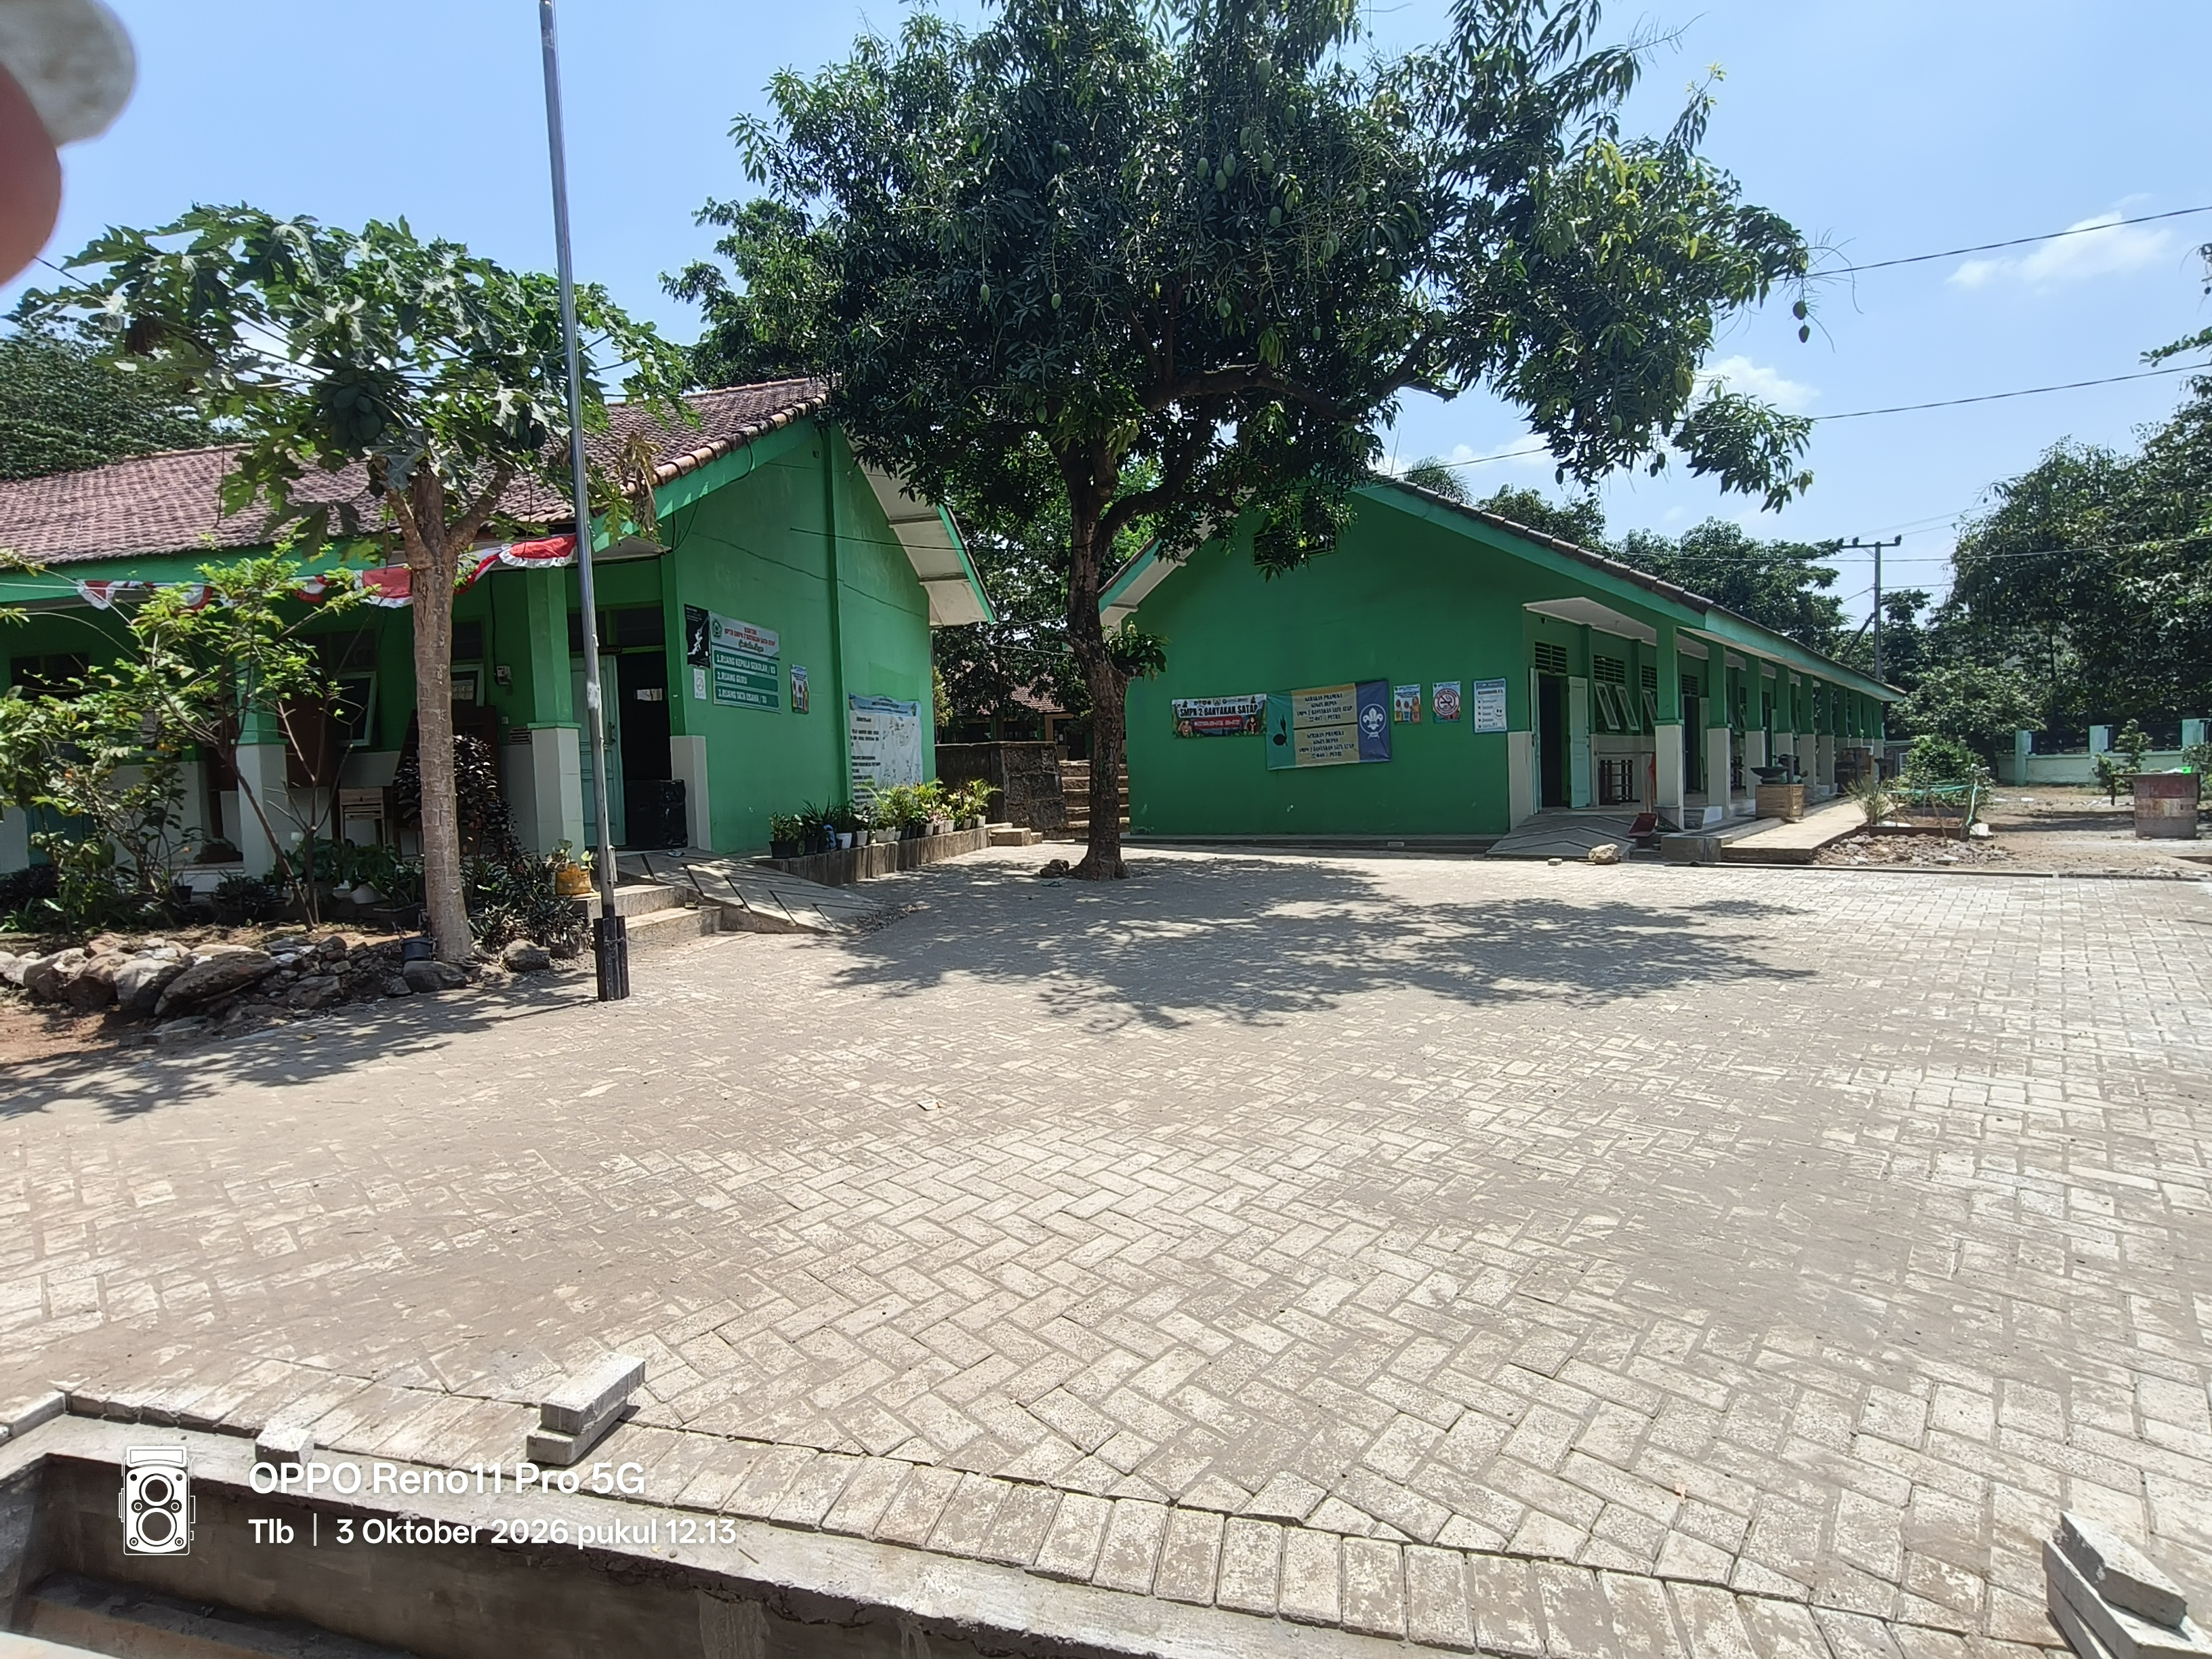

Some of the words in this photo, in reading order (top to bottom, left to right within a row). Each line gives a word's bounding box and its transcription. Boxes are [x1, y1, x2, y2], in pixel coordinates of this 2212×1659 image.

[1180, 708, 1197, 717] SMPN
[1198, 708, 1204, 716] 2
[1204, 705, 1236, 716] BANYAKAN
[1237, 703, 1258, 714] SATAP
